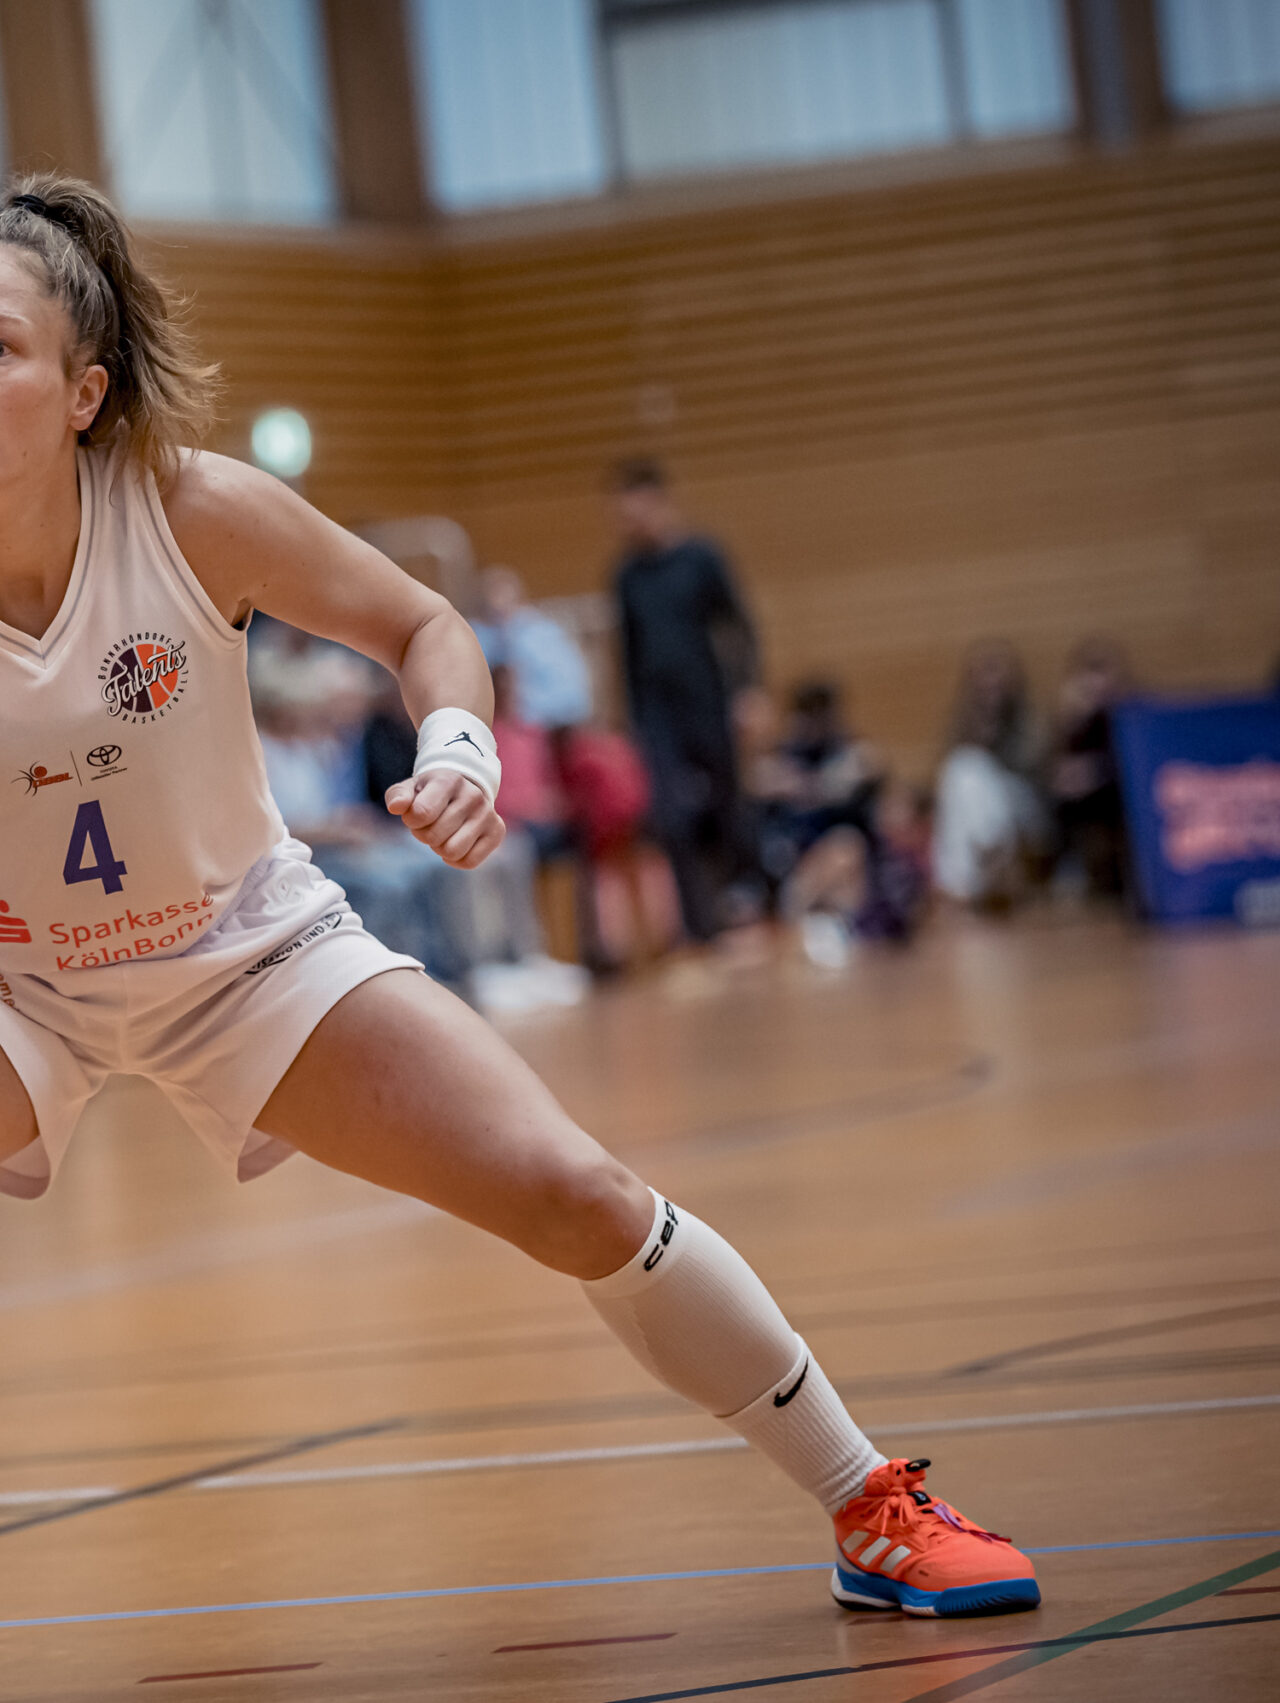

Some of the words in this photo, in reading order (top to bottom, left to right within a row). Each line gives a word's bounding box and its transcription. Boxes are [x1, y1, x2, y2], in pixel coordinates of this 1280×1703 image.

[101, 640, 187, 717] Talents
[62, 799, 128, 896] 4
[48, 892, 214, 949] Sparkasse
[643, 1200, 679, 1272] cep
